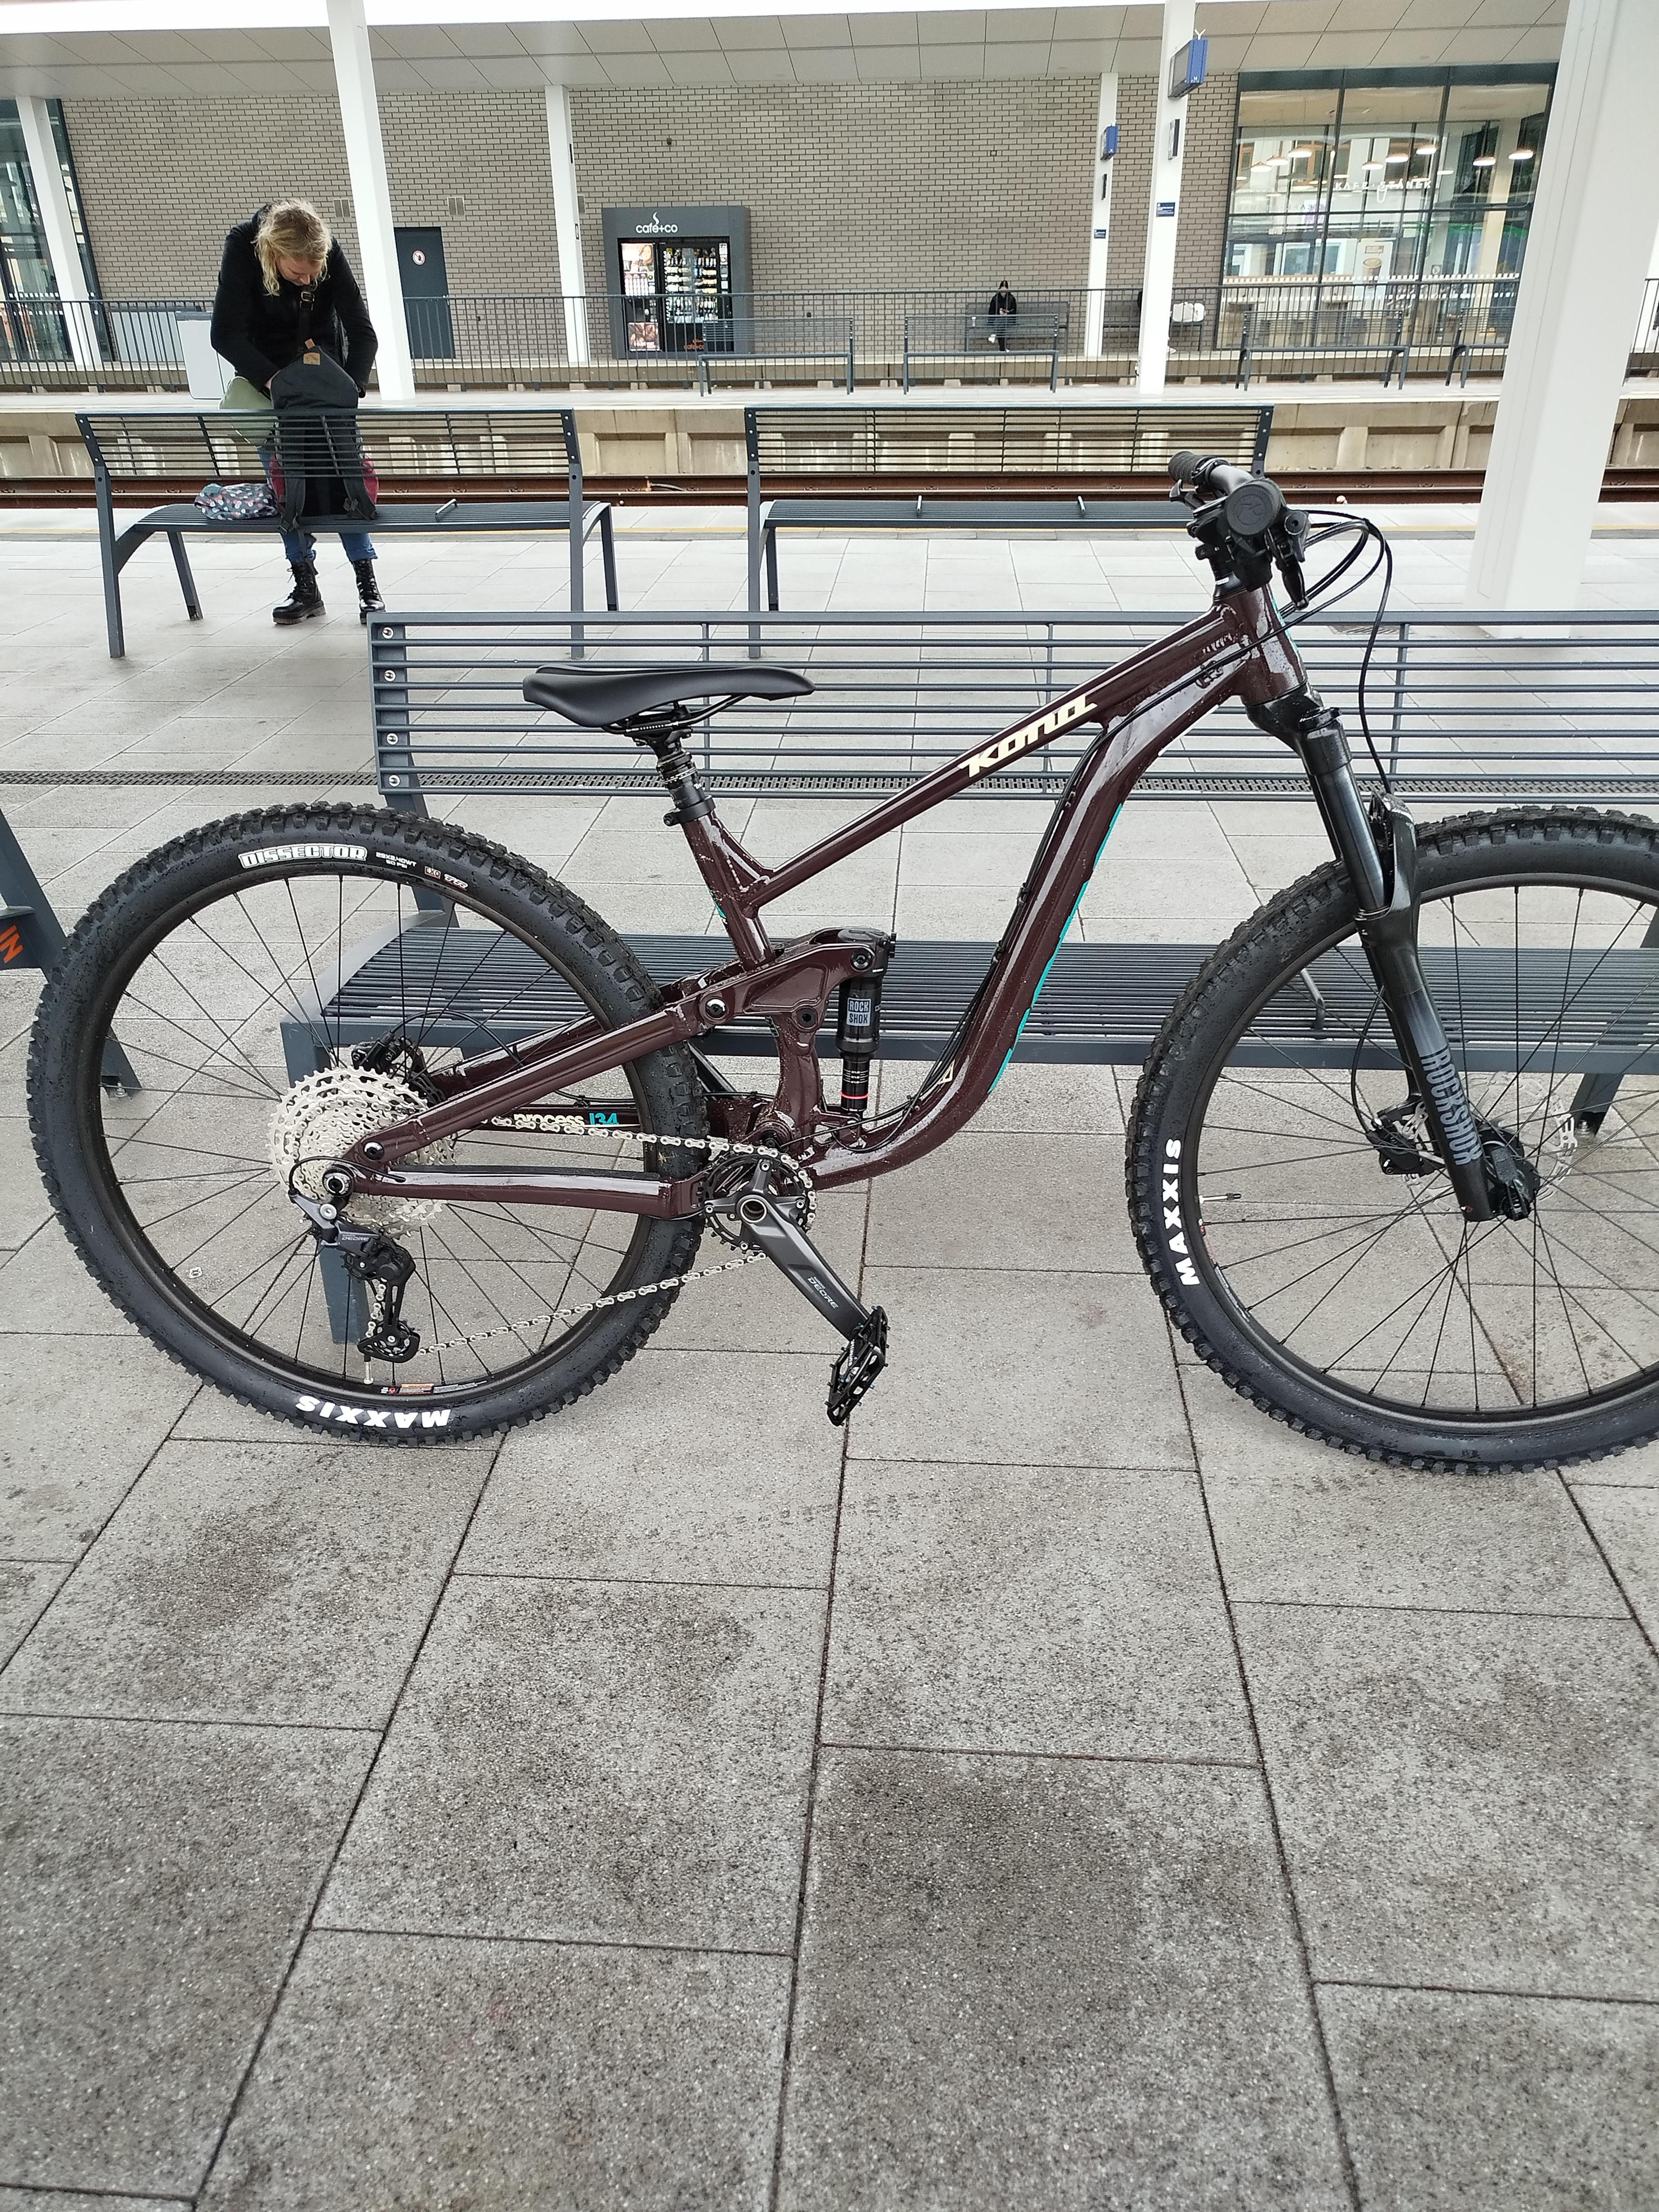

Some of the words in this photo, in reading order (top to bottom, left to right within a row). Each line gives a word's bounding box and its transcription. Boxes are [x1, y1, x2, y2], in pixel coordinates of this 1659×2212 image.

[238, 843, 368, 868] DISSECTOR
[425, 866, 441, 879] EXO
[849, 1001, 869, 1011] ROCK
[849, 1013, 868, 1024] SHOX
[1420, 1048, 1483, 1165] ROCKSHOX
[1162, 1138, 1200, 1285] MAXXIS
[807, 1277, 839, 1309] DEORE
[295, 1395, 451, 1428] MAXXIS
